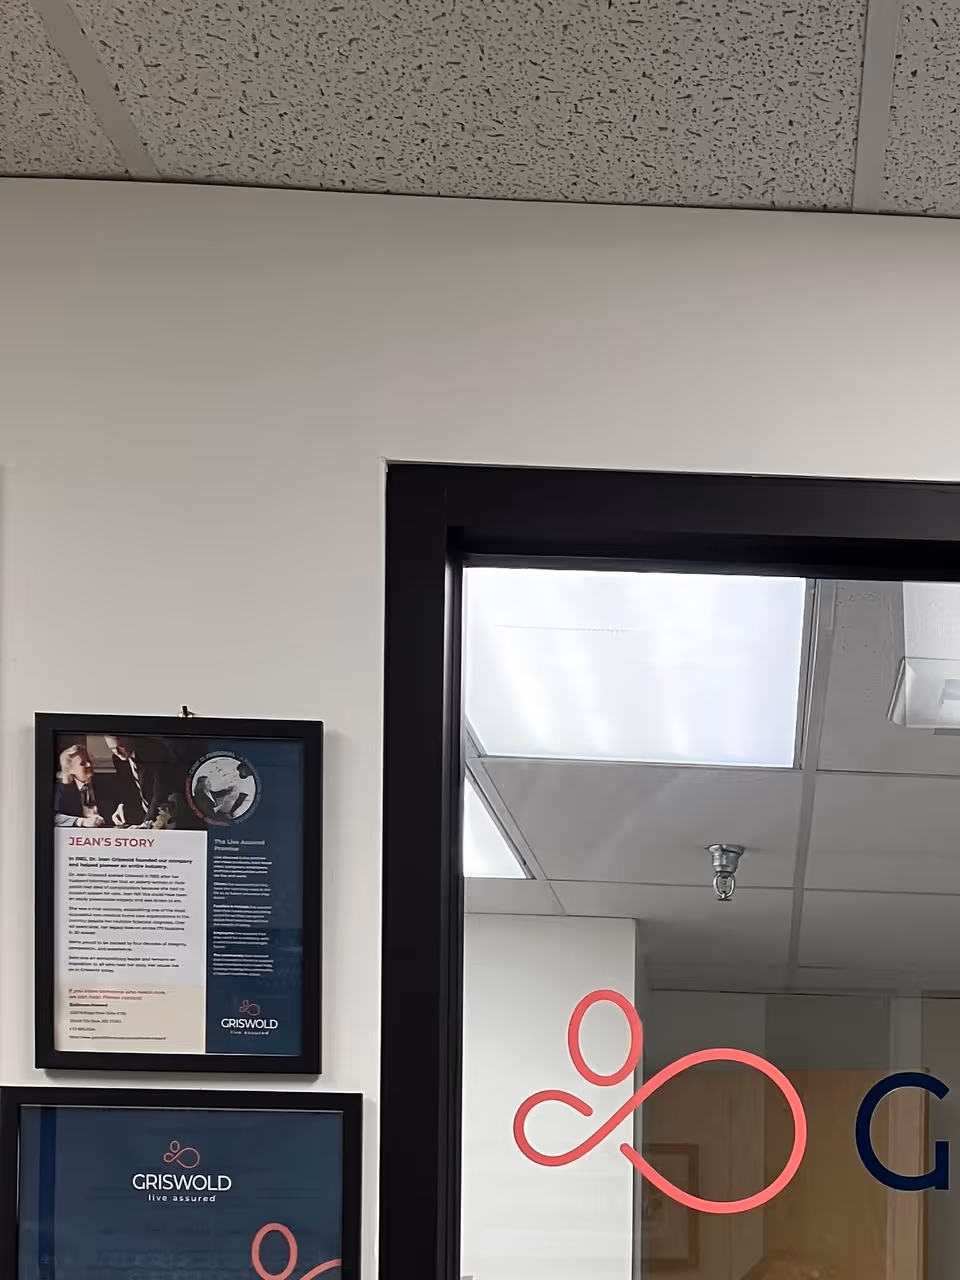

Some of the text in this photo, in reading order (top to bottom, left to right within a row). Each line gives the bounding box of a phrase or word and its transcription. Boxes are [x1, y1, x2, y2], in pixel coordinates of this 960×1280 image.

[68, 837, 155, 847] JEAN'S STORY
[221, 1018, 279, 1029] GRISWOLD
[132, 1174, 232, 1191] GRISWOLD
[172, 1194, 216, 1202] assured
